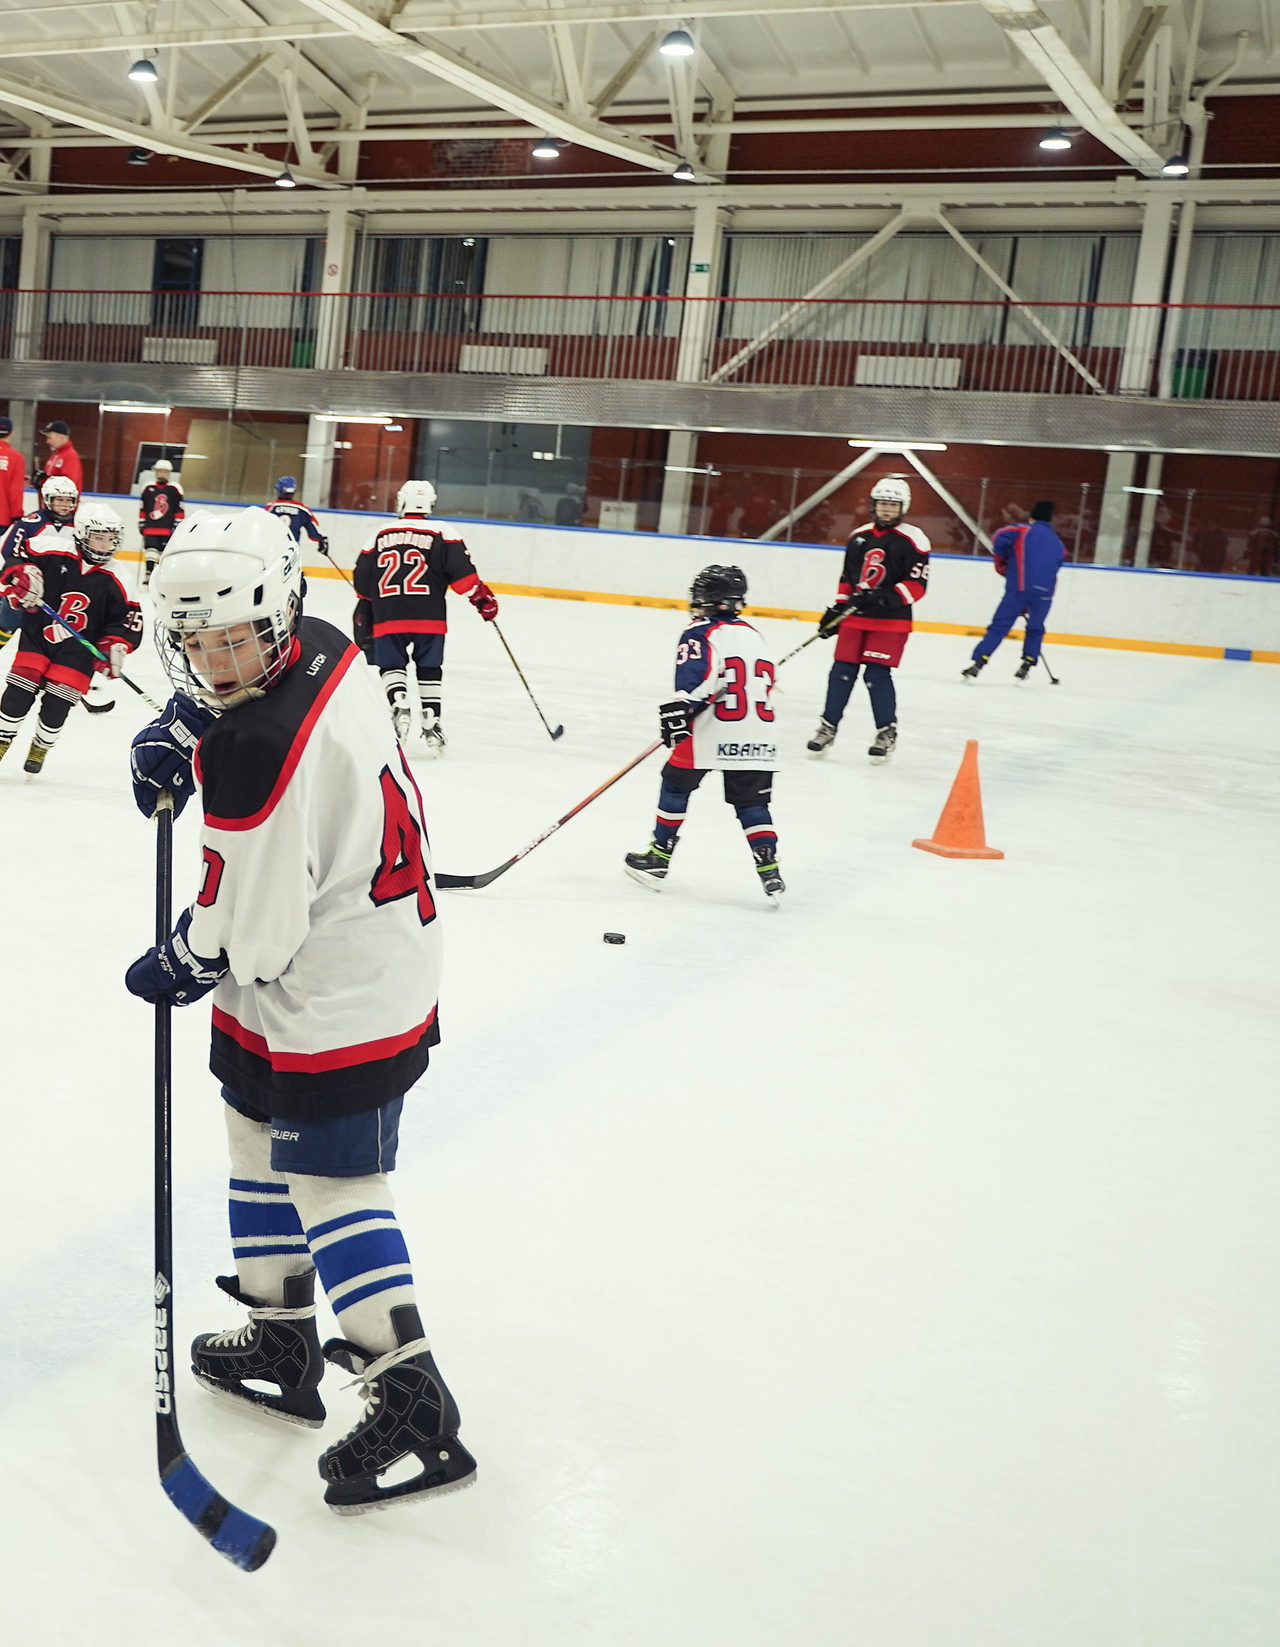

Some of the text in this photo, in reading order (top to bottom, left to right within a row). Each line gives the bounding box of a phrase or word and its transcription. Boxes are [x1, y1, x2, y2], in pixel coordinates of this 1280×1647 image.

[377, 549, 430, 598] 22
[676, 638, 702, 665] 33
[306, 653, 327, 678] LUTCH
[714, 656, 776, 722] 33
[270, 1128, 300, 1142] AUER
